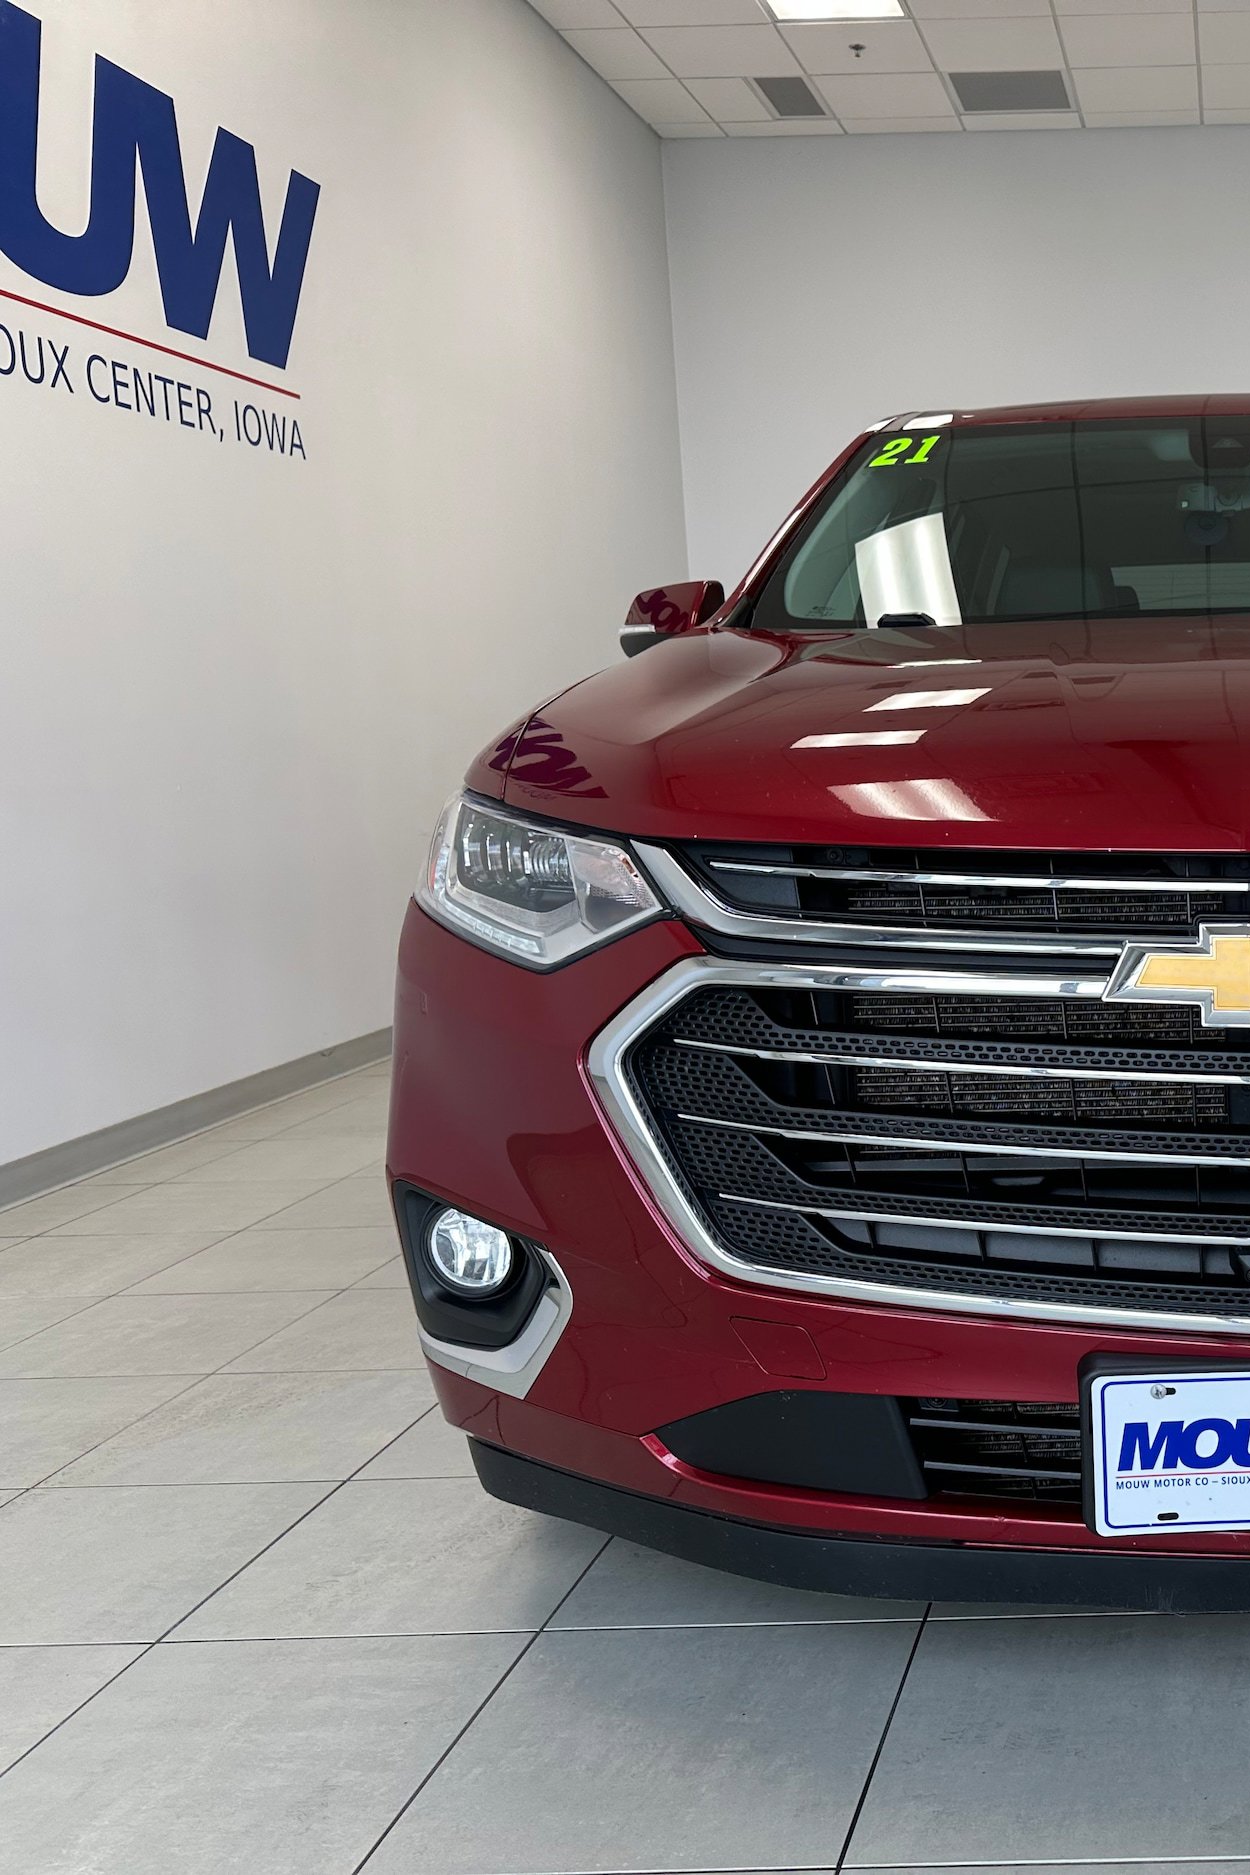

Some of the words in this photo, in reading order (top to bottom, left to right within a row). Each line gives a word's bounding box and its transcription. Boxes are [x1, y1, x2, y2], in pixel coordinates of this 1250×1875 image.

[86, 354, 224, 443] CENTER,
[234, 400, 307, 460] IOWA
[868, 435, 941, 468] 21
[1115, 1480, 1151, 1490] MOUW
[1154, 1478, 1192, 1488] MOTOR
[1195, 1477, 1209, 1486] CO
